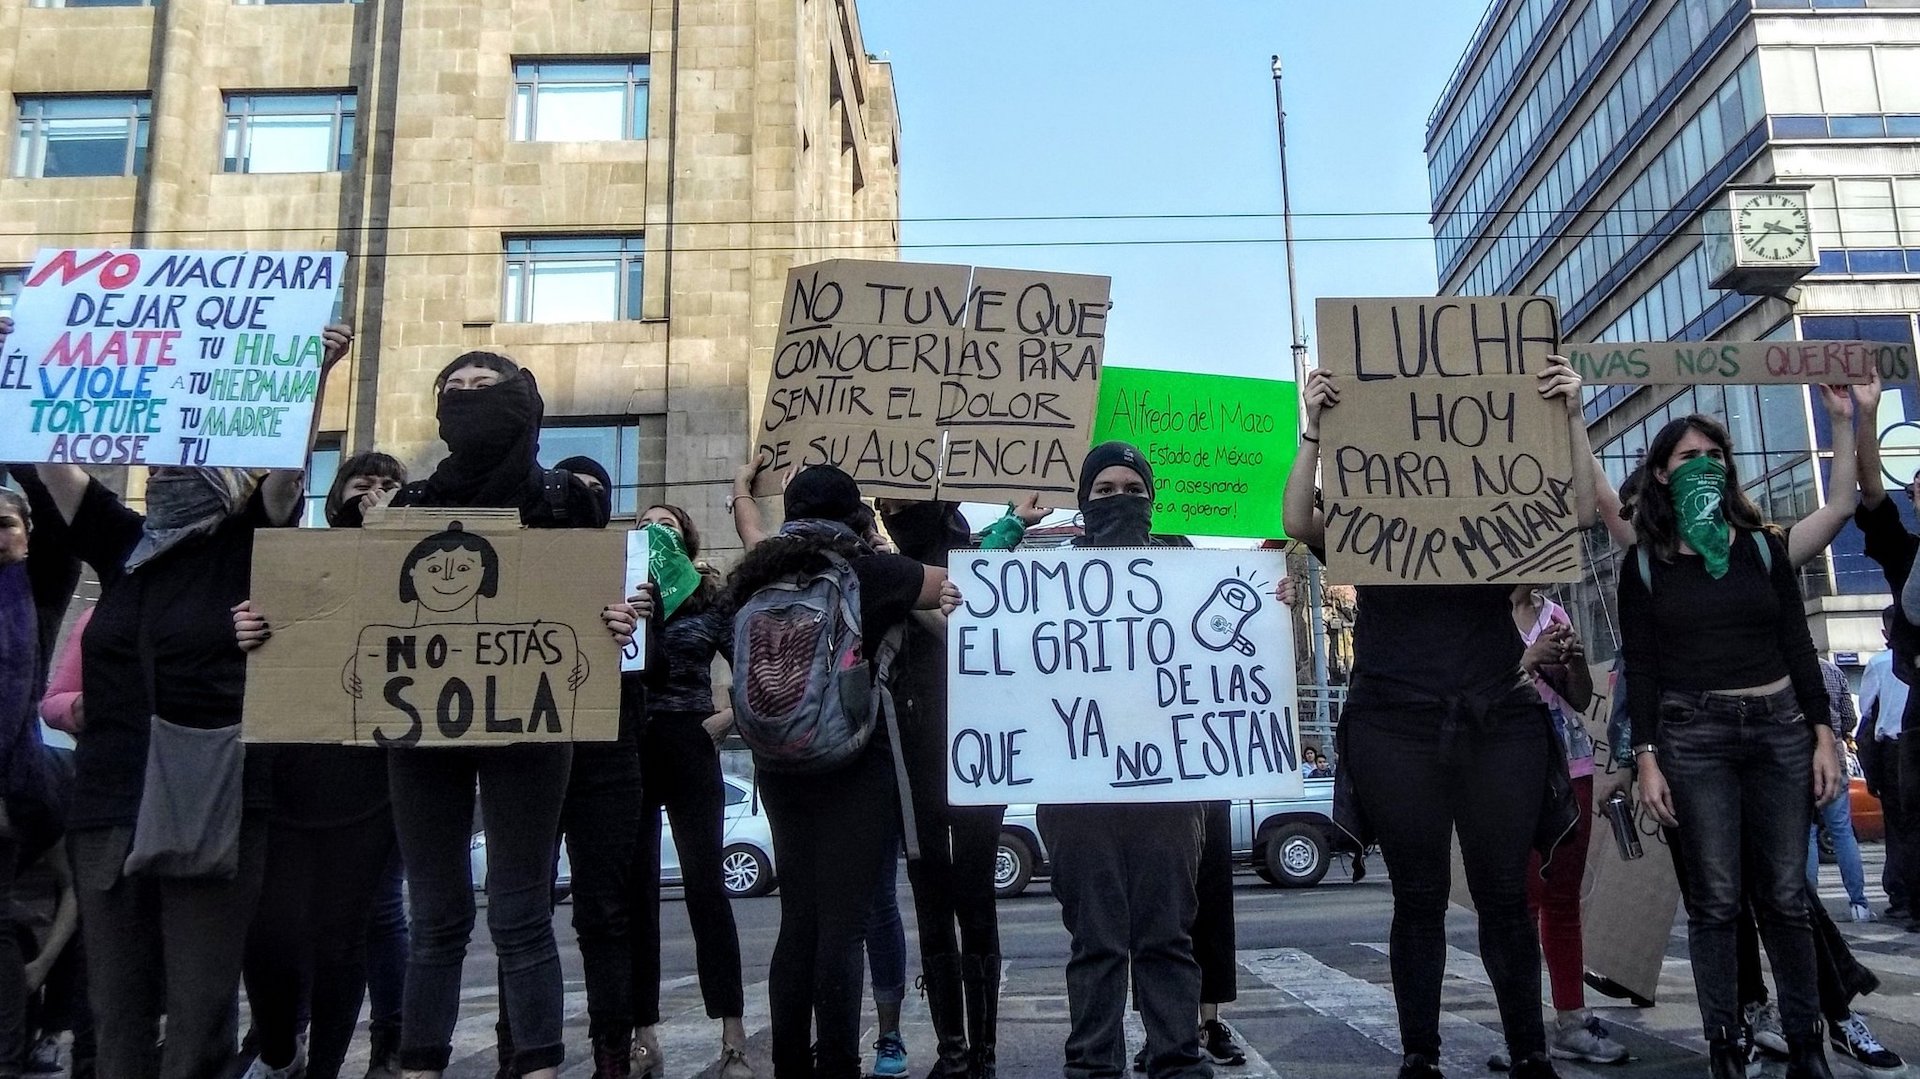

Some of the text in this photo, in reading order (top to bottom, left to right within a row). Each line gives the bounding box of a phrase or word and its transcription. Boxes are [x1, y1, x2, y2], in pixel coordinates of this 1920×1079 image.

[25, 250, 332, 290] NO NACÍ PARA
[66, 293, 274, 329] DEJAR QUE
[788, 271, 1106, 338] NO TUVE QUE
[41, 331, 323, 367] MATE TU HIJA
[775, 332, 1097, 381] CONOCERLAS PARA
[1353, 298, 1558, 382] LUCHA
[1675, 345, 1740, 378] NOS
[1765, 342, 1909, 380] QUEREMOS
[0, 347, 32, 390] ÉL
[38, 366, 157, 399] VIOLE
[189, 372, 210, 395] TU
[210, 369, 317, 402] HERMANA
[29, 398, 289, 437] TORTURE TU MADRE
[765, 375, 1070, 432] SENTIR EL DOLOR
[1108, 387, 1274, 437] Alfredo del Mazo
[1410, 391, 1515, 447] HOY
[50, 434, 210, 466] ACOSE TU
[759, 429, 1075, 483] DE SU AUSENCIA
[1149, 443, 1190, 466] Estado
[1193, 445, 1210, 468] de
[1214, 447, 1263, 468] México
[1336, 445, 1544, 498] PARA NO
[1325, 503, 1446, 580] MORIR
[1452, 477, 1573, 579] MAÑANA
[965, 558, 1163, 618] SOMOS
[475, 619, 562, 666] ESTÁS
[958, 616, 1176, 676] EL GRITO
[372, 671, 562, 748] SOLA
[1157, 664, 1272, 708] DE LAS
[952, 697, 1298, 788] QUE YA NO ESTÁN
